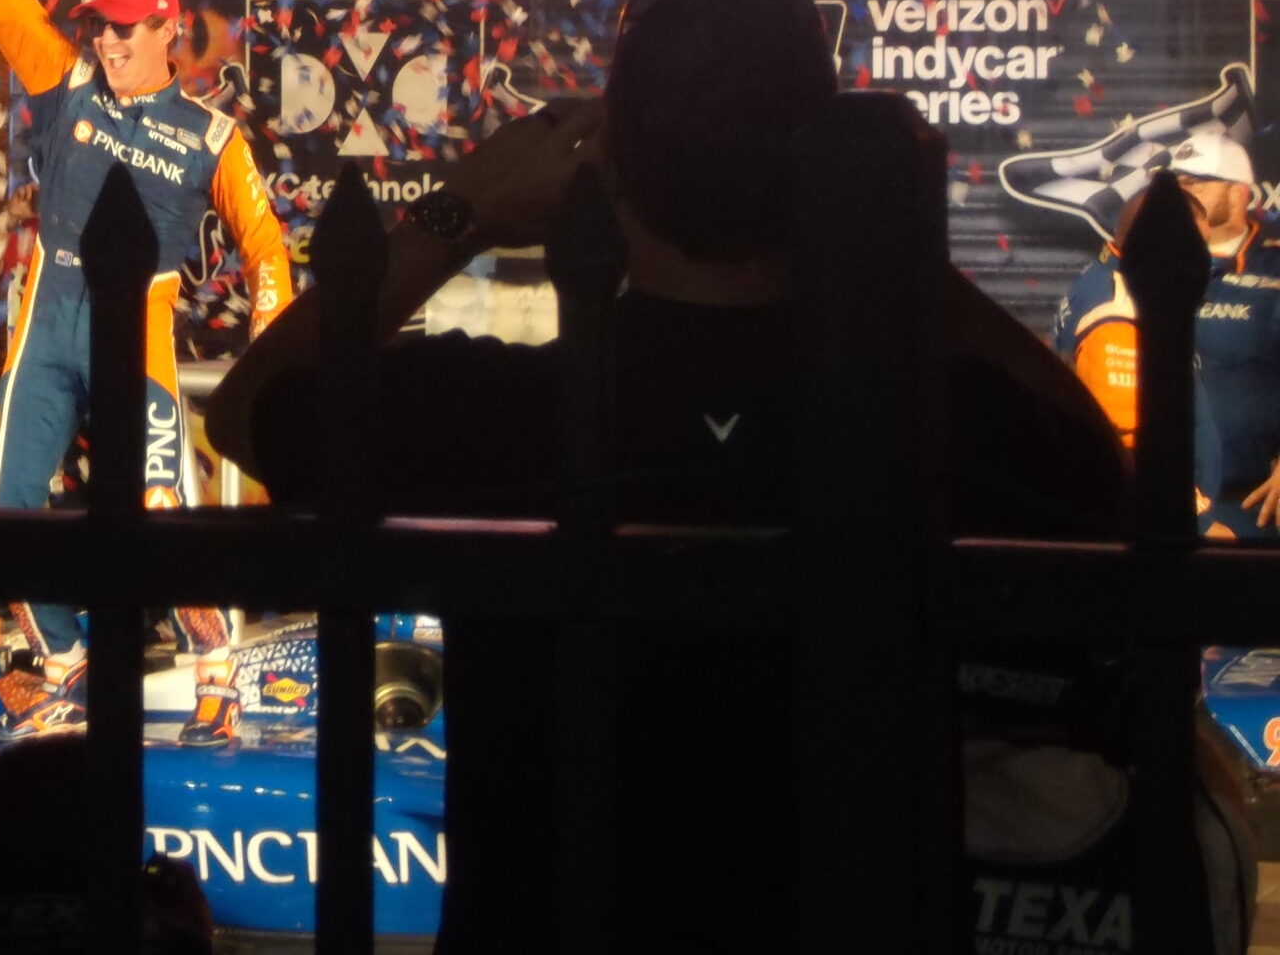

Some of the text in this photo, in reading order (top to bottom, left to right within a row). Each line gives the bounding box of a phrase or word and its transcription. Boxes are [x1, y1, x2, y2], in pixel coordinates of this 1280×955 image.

[872, 36, 1058, 90] indycar
[92, 129, 185, 184] PNC BANK
[145, 402, 177, 483] PNC
[265, 684, 311, 695] SUNOCO
